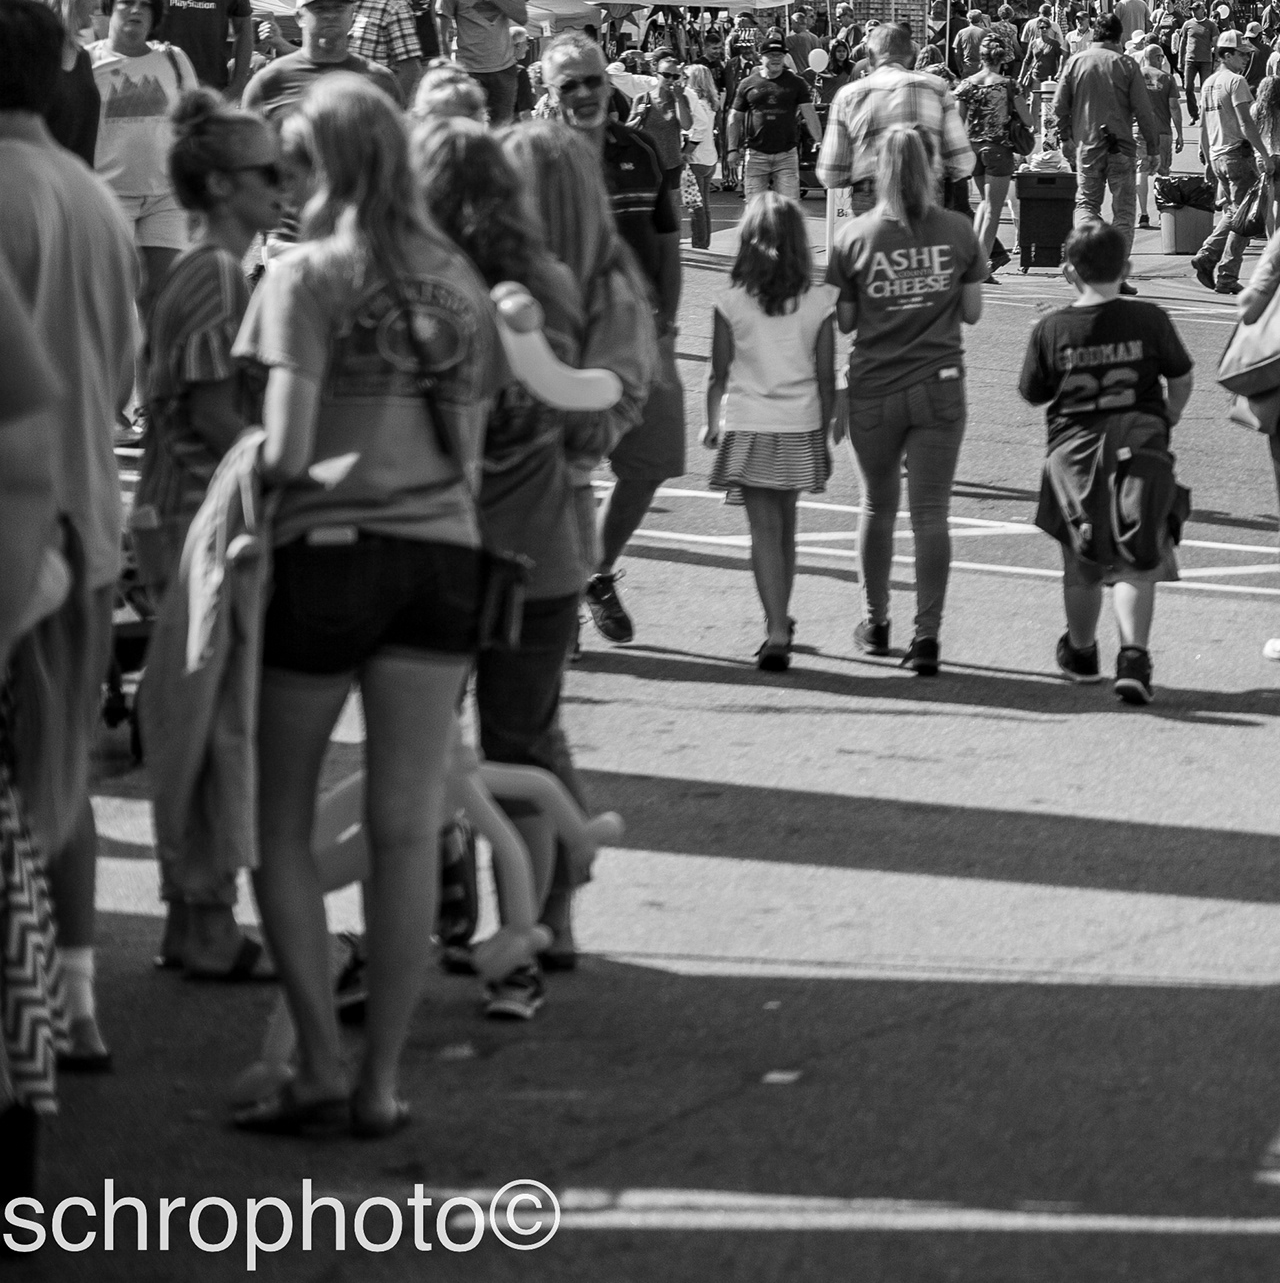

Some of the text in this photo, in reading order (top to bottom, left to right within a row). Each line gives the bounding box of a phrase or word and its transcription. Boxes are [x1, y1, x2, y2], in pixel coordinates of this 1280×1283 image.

[866, 245, 954, 284] ASHE
[867, 274, 951, 298] CHEESE
[1059, 367, 1139, 414] 22
